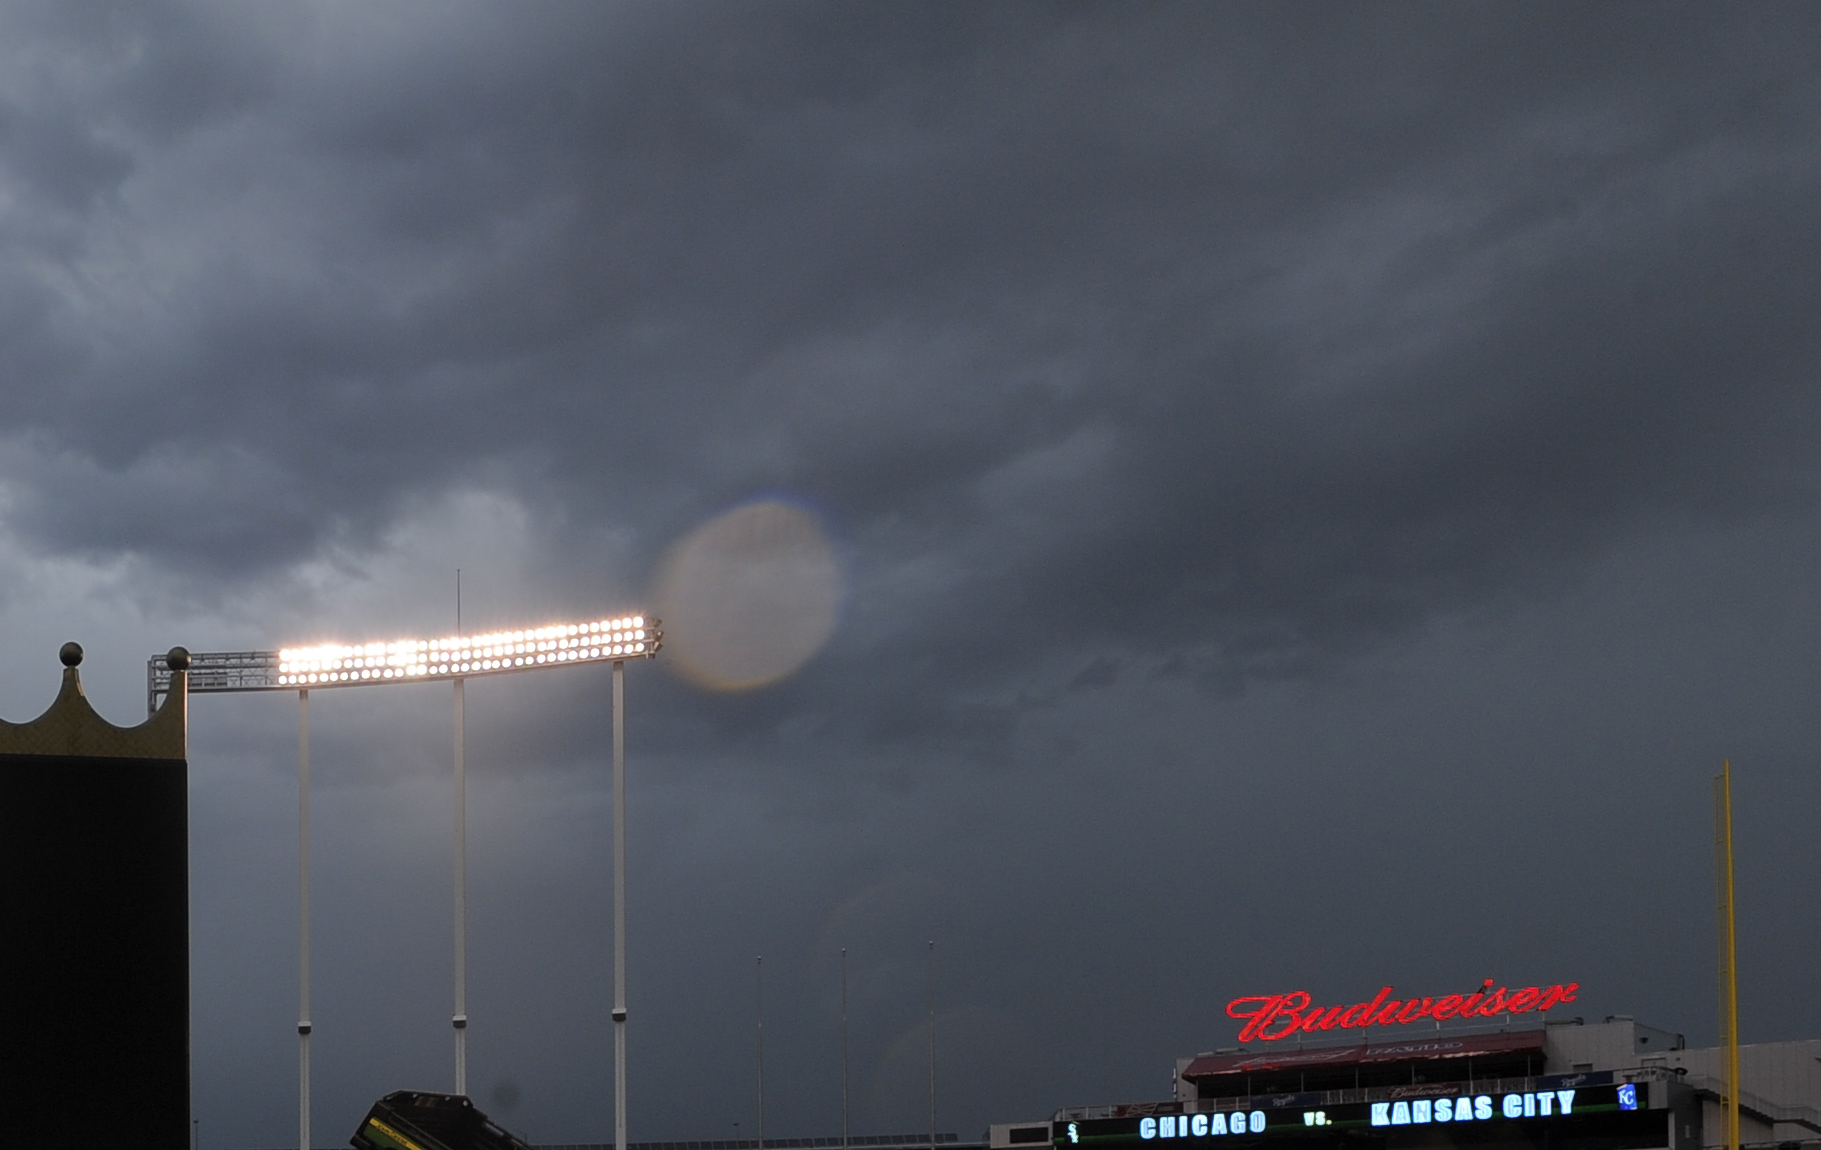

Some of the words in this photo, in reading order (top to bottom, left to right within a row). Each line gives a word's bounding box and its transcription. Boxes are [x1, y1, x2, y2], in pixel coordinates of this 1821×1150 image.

[1225, 978, 1579, 1043] Budweiser
[1139, 1110, 1267, 1140] CHICAGO
[1371, 1095, 1493, 1127] KANSAS
[1502, 1089, 1576, 1118] CITY
